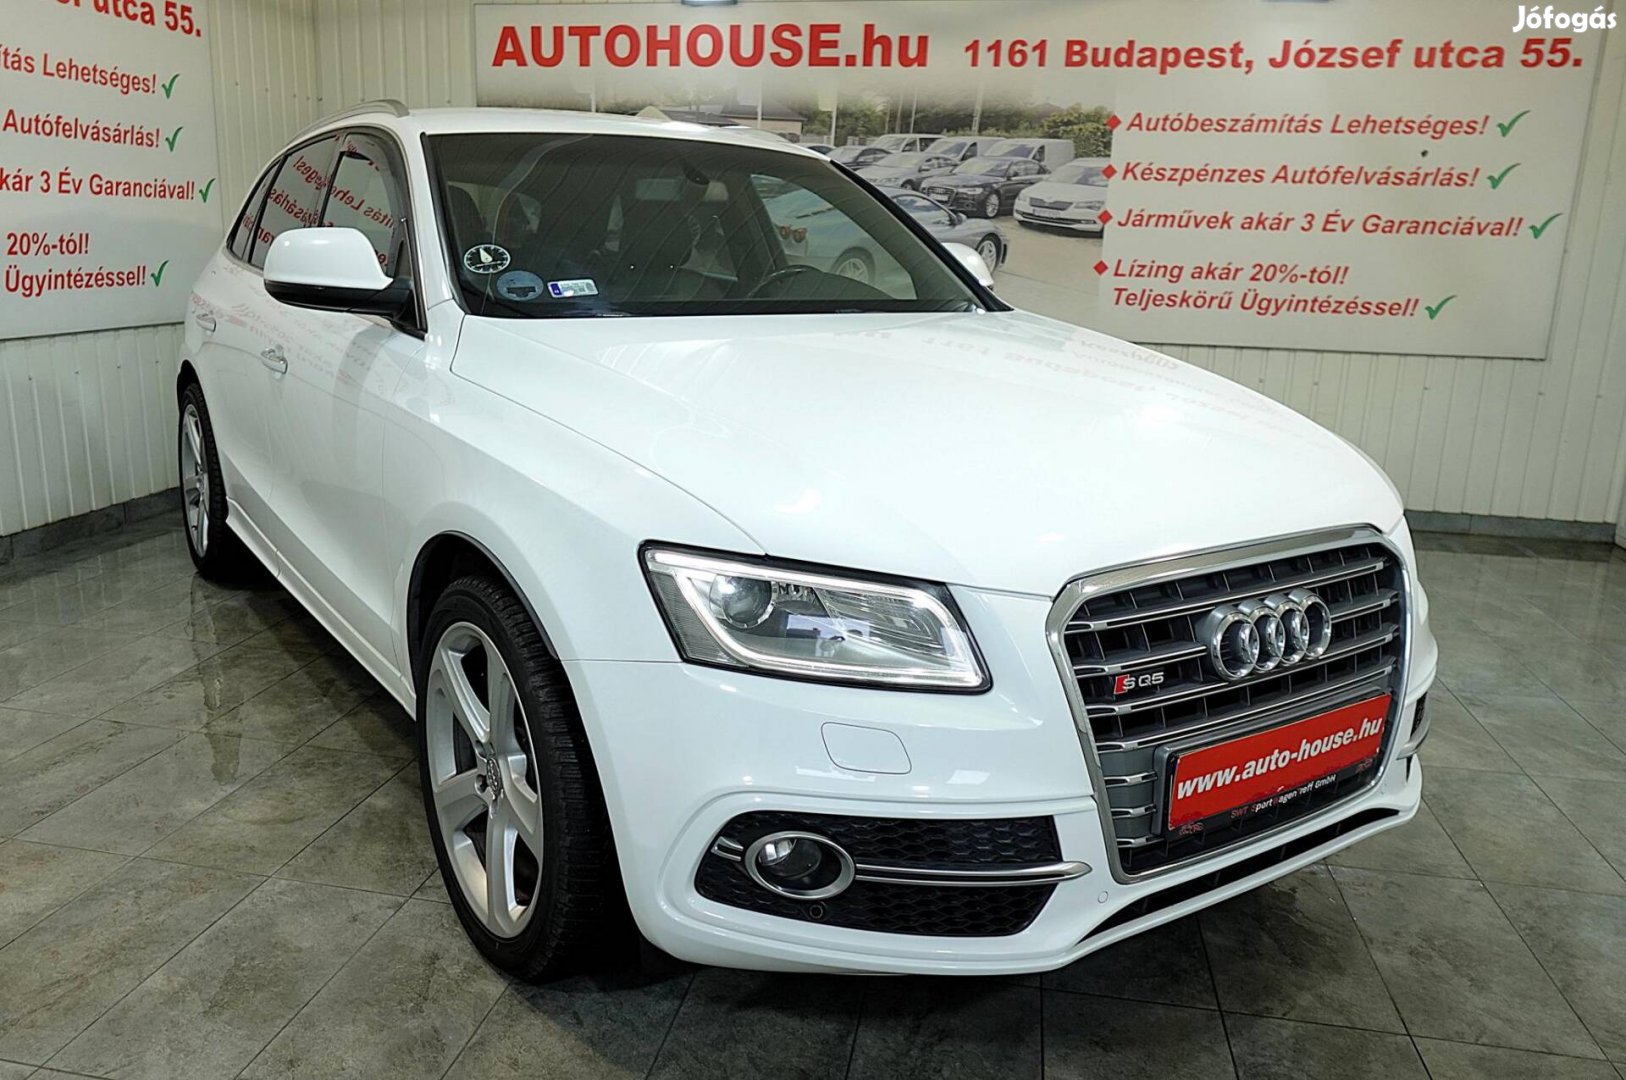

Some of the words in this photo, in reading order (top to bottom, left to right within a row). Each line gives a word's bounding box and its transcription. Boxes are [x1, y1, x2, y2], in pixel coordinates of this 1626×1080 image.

[92, 0, 156, 27] utca
[164, 0, 202, 37] 55.
[492, 23, 929, 68] AUTOHOUSE.hu
[964, 38, 1049, 68] 1161
[1064, 39, 1254, 75] Budapest,
[1268, 38, 1402, 70] József
[1412, 40, 1506, 70] utca
[1520, 37, 1583, 68] 55.
[42, 53, 157, 96] Lehetséges!
[2, 108, 160, 147] Autófelvásárlás!
[1126, 111, 1323, 135] Autóbeszámítás
[1330, 115, 1489, 140] Lehetséges!
[40, 170, 51, 193] 3
[57, 166, 83, 195] Év
[89, 173, 195, 200] Garanciával!
[1120, 163, 1266, 185] Készpénzes
[1271, 164, 1480, 188] Autófelvásárlás!
[1117, 208, 1233, 231] Járművek
[1239, 212, 1293, 232] akár
[1301, 212, 1315, 233] 3
[1321, 210, 1354, 234] Év
[1361, 213, 1524, 237] Garanciával!
[7, 231, 89, 256] 20%-tól!
[5, 264, 146, 298] Ügyintézéssel!
[1112, 259, 1184, 284] Lízing
[1190, 263, 1243, 281] akár
[1249, 263, 1349, 285] 20%-tól!
[1113, 287, 1233, 313] Teljeskörű
[1239, 292, 1420, 317] Ügyintézéssel!
[1177, 717, 1383, 800] www.auto-house.hu
